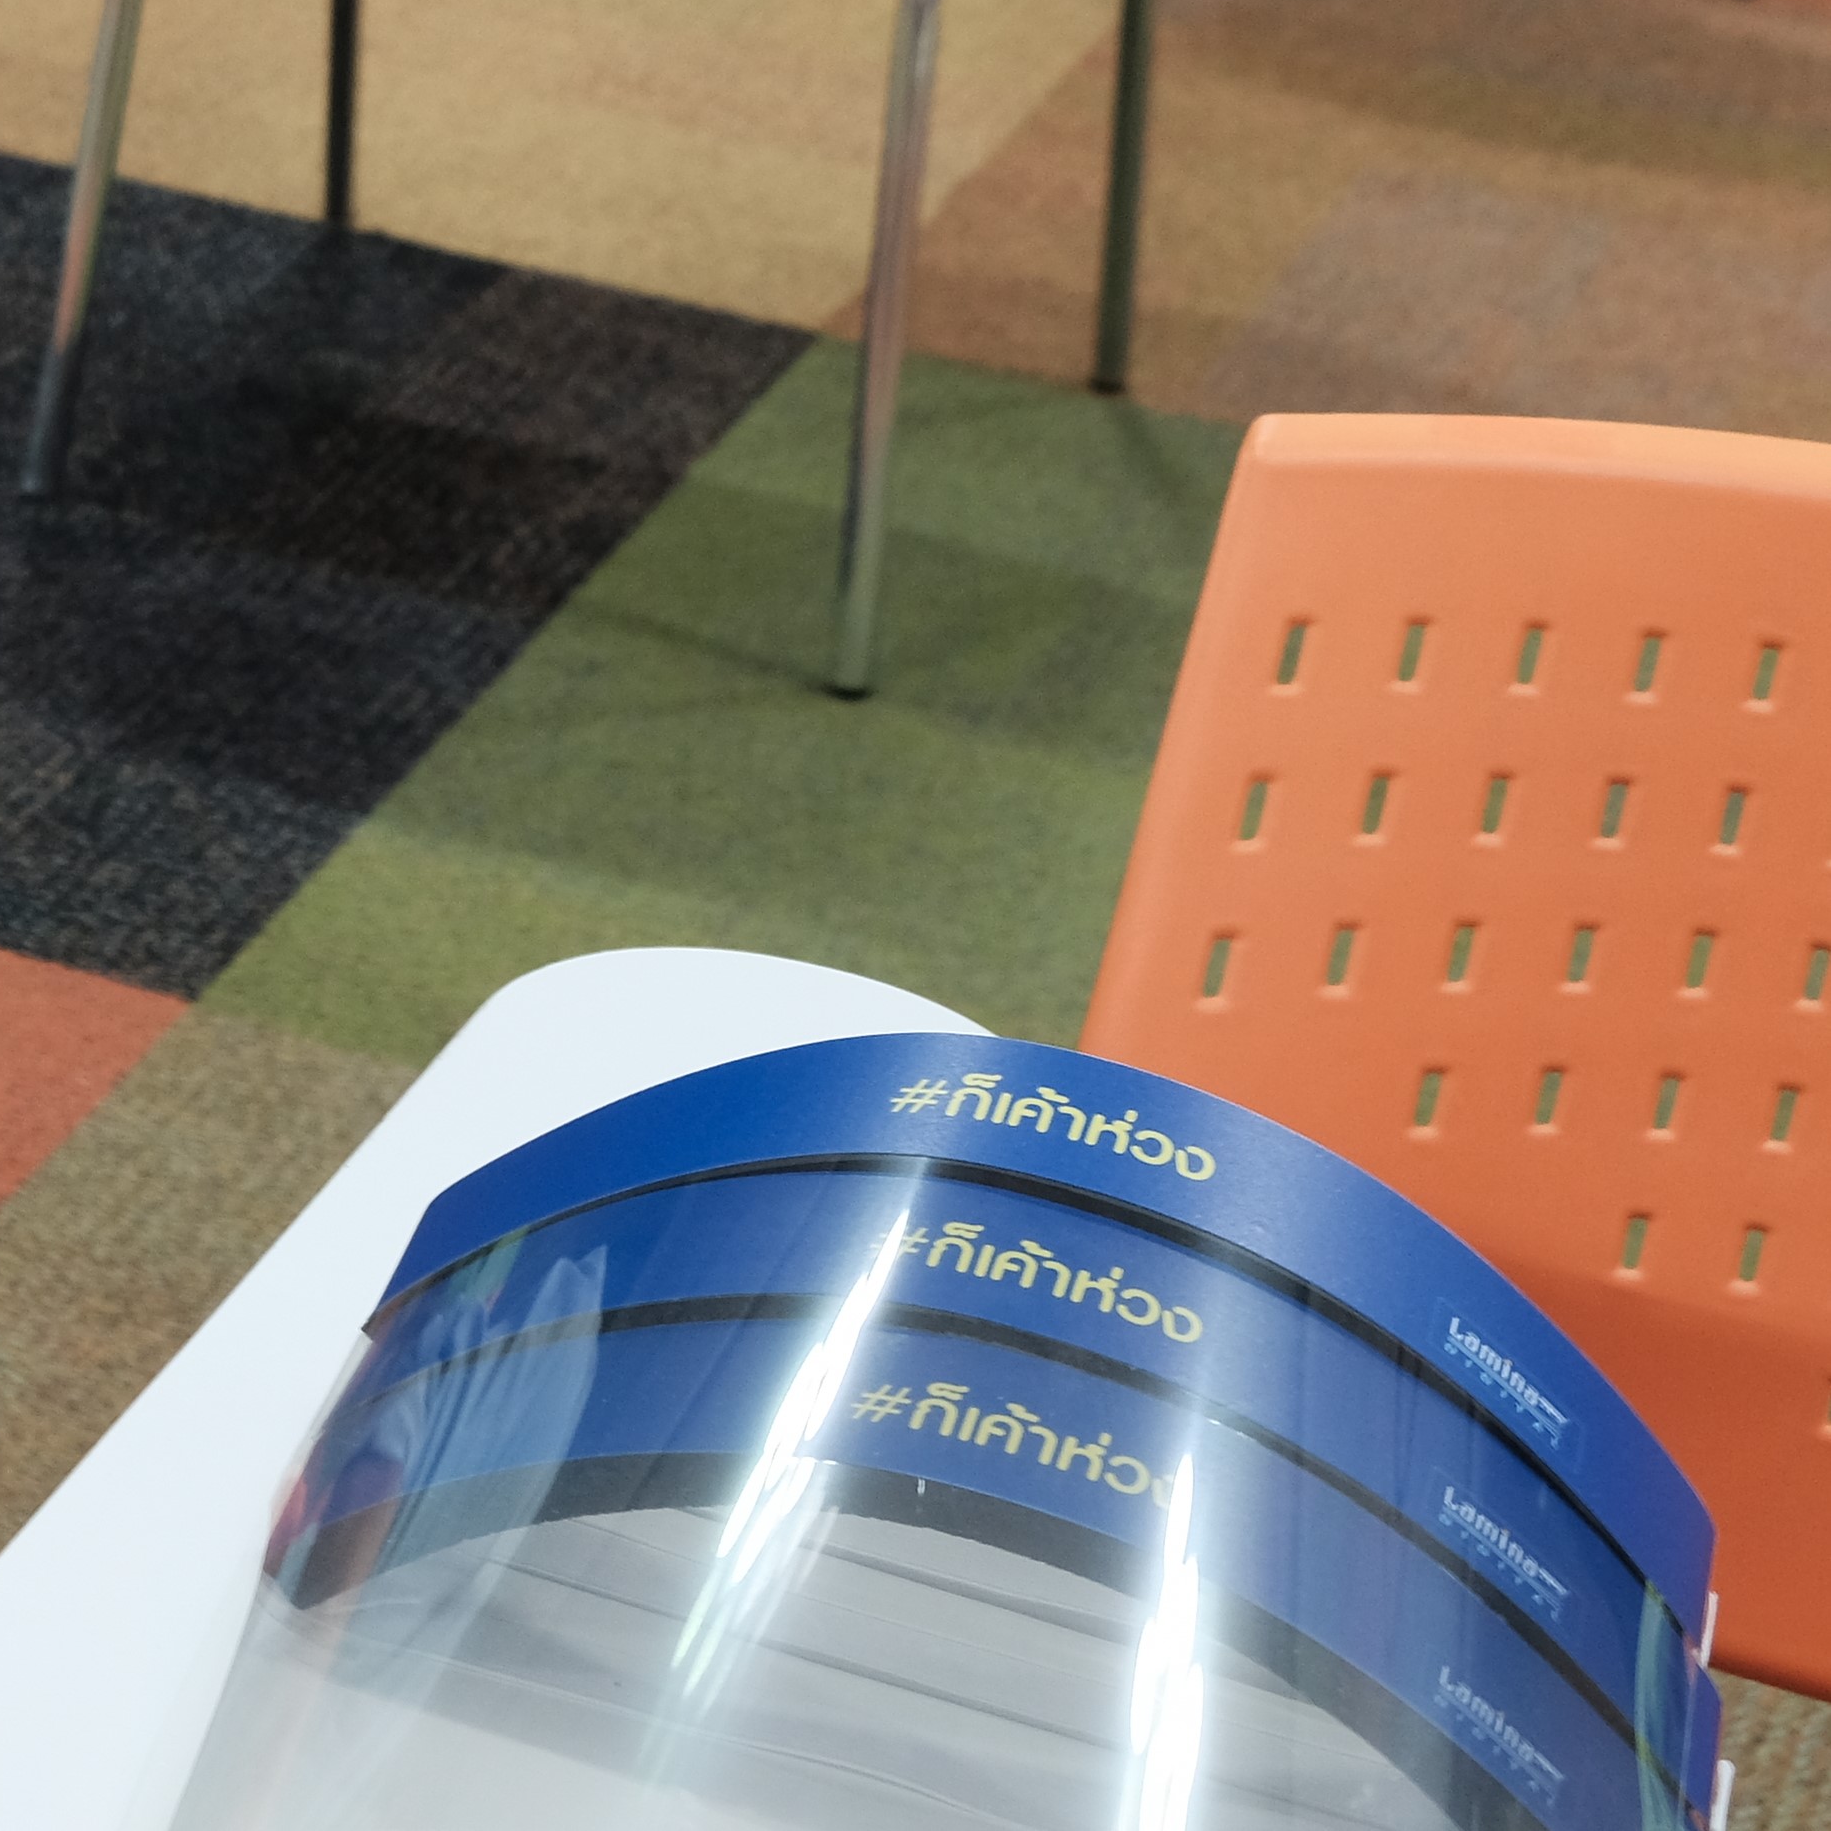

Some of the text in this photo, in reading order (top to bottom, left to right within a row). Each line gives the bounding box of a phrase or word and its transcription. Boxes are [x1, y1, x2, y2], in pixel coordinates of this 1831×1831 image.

[890, 1072, 1217, 1181] #ก็เค้าห่วง
[1448, 1316, 1567, 1423] Lamina
